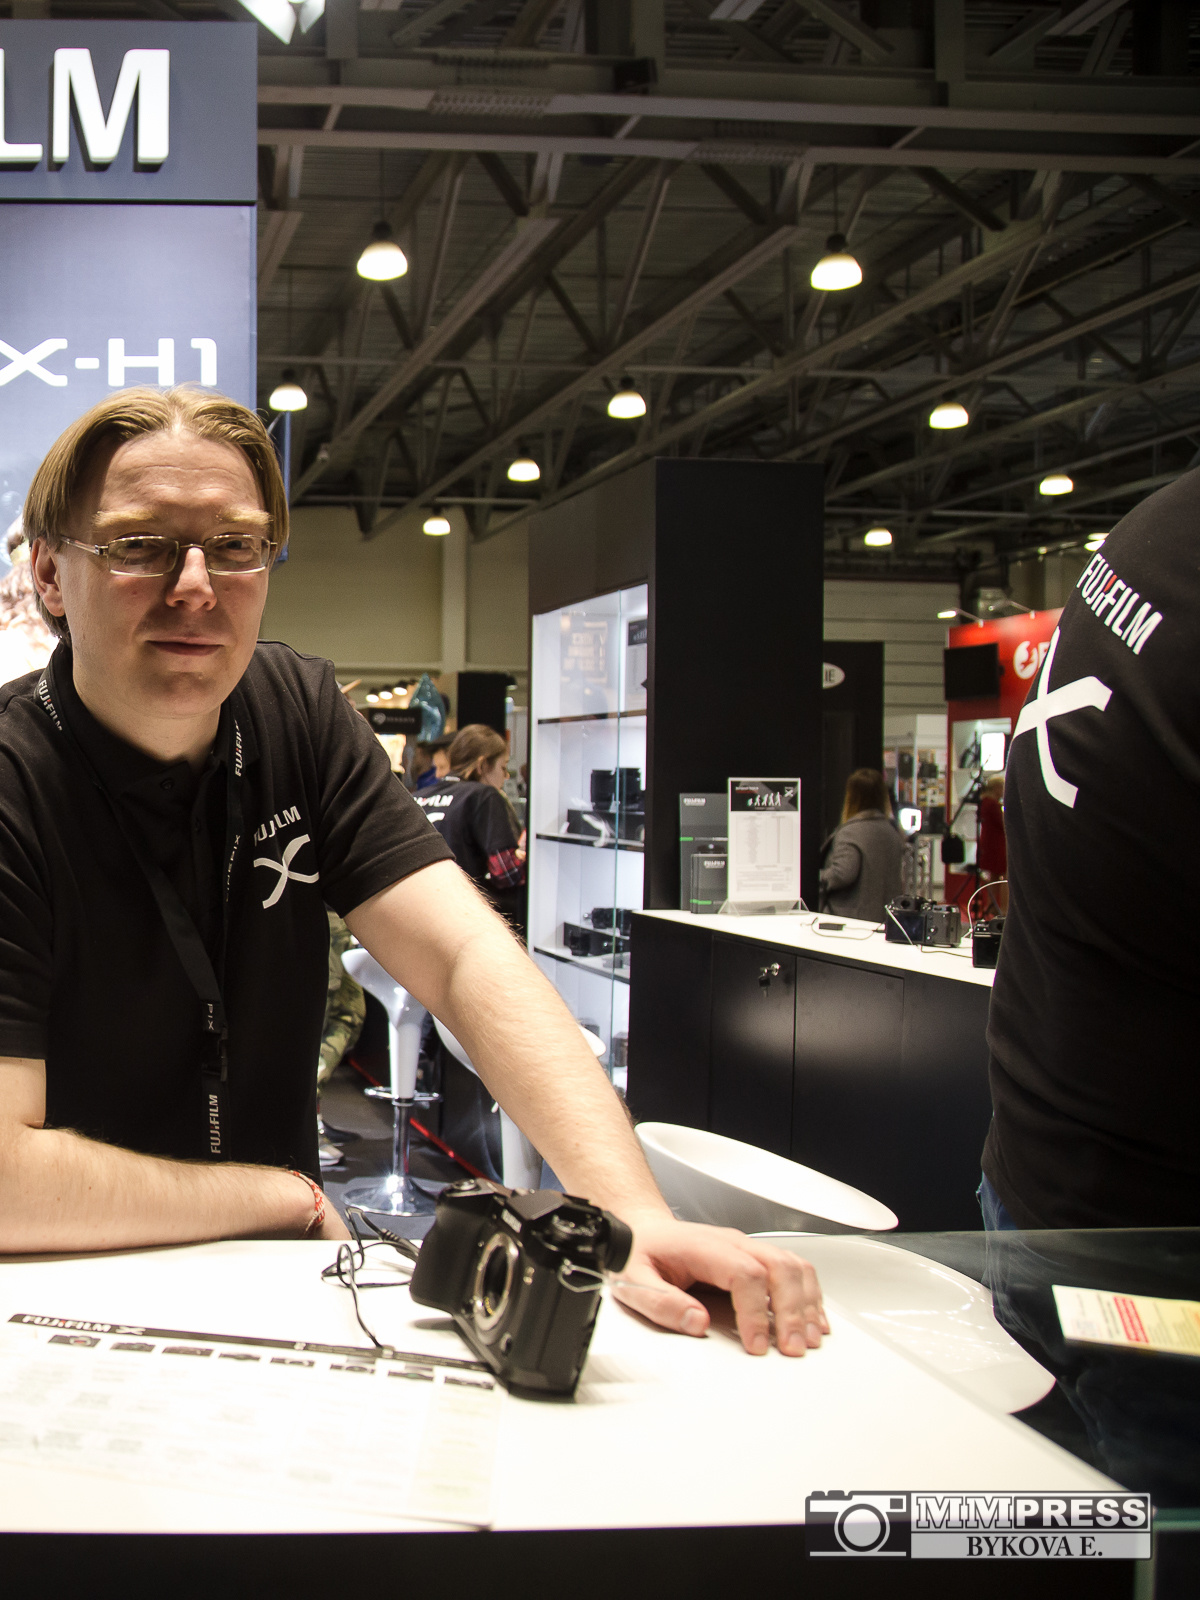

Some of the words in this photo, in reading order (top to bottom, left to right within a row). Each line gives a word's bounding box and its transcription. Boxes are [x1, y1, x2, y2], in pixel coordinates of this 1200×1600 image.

[1075, 552, 1164, 656] FUJIFILM
[208, 1094, 222, 1154] FUJIFILM
[22, 1315, 112, 1333] FUJIFILM
